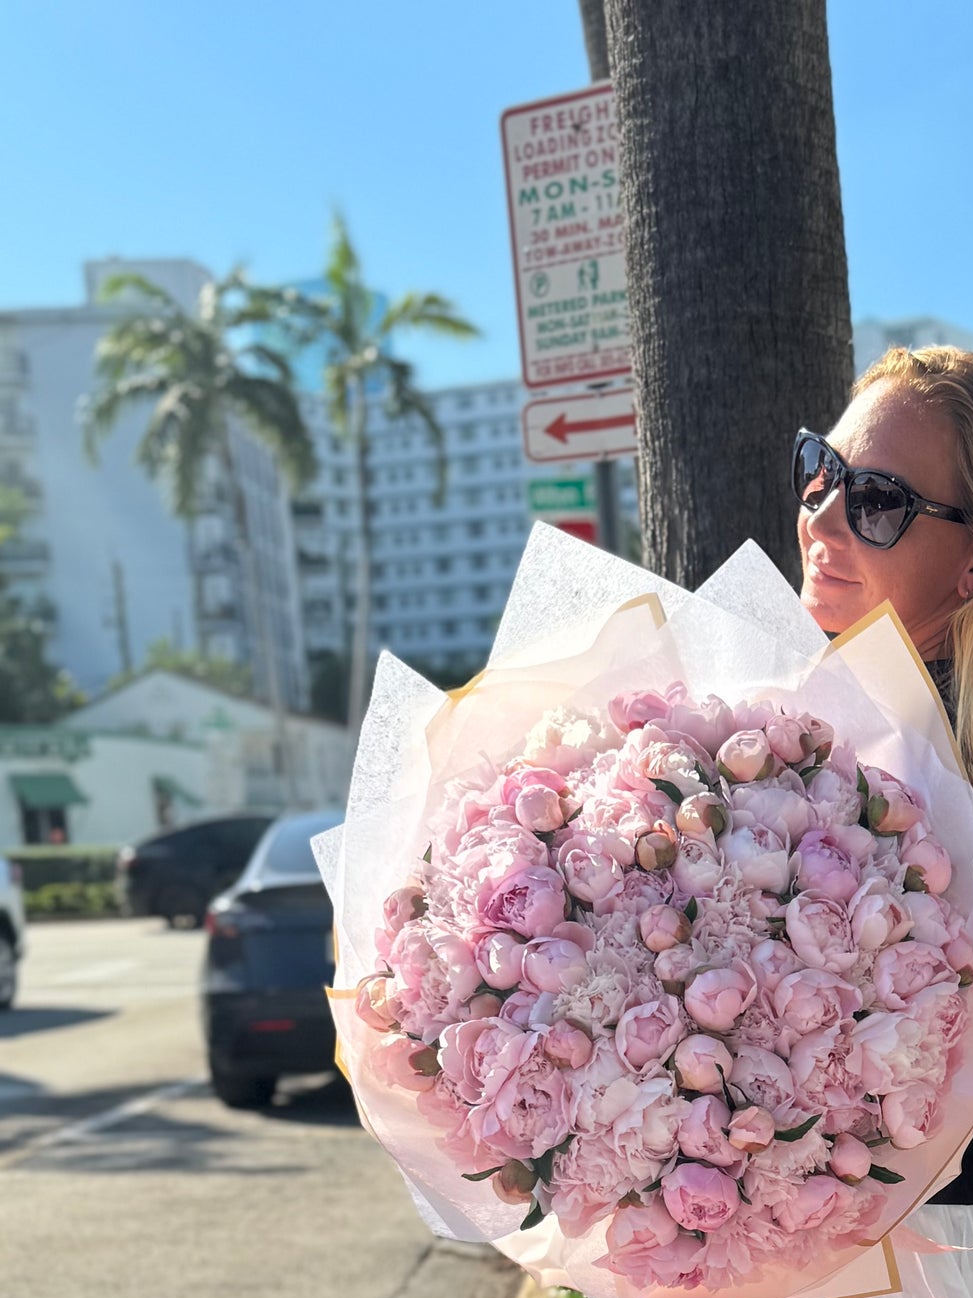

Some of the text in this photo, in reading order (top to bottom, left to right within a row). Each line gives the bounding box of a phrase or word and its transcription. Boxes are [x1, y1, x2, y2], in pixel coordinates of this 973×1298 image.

[530, 99, 617, 136] FREIGH
[514, 122, 619, 162] LOADING ZO
[522, 146, 616, 181] PERMIT ON
[519, 168, 617, 206] MON-S
[598, 213, 624, 230] MA
[525, 231, 625, 262] TOW-AWAY-ZO
[528, 289, 627, 319] METERED PARK
